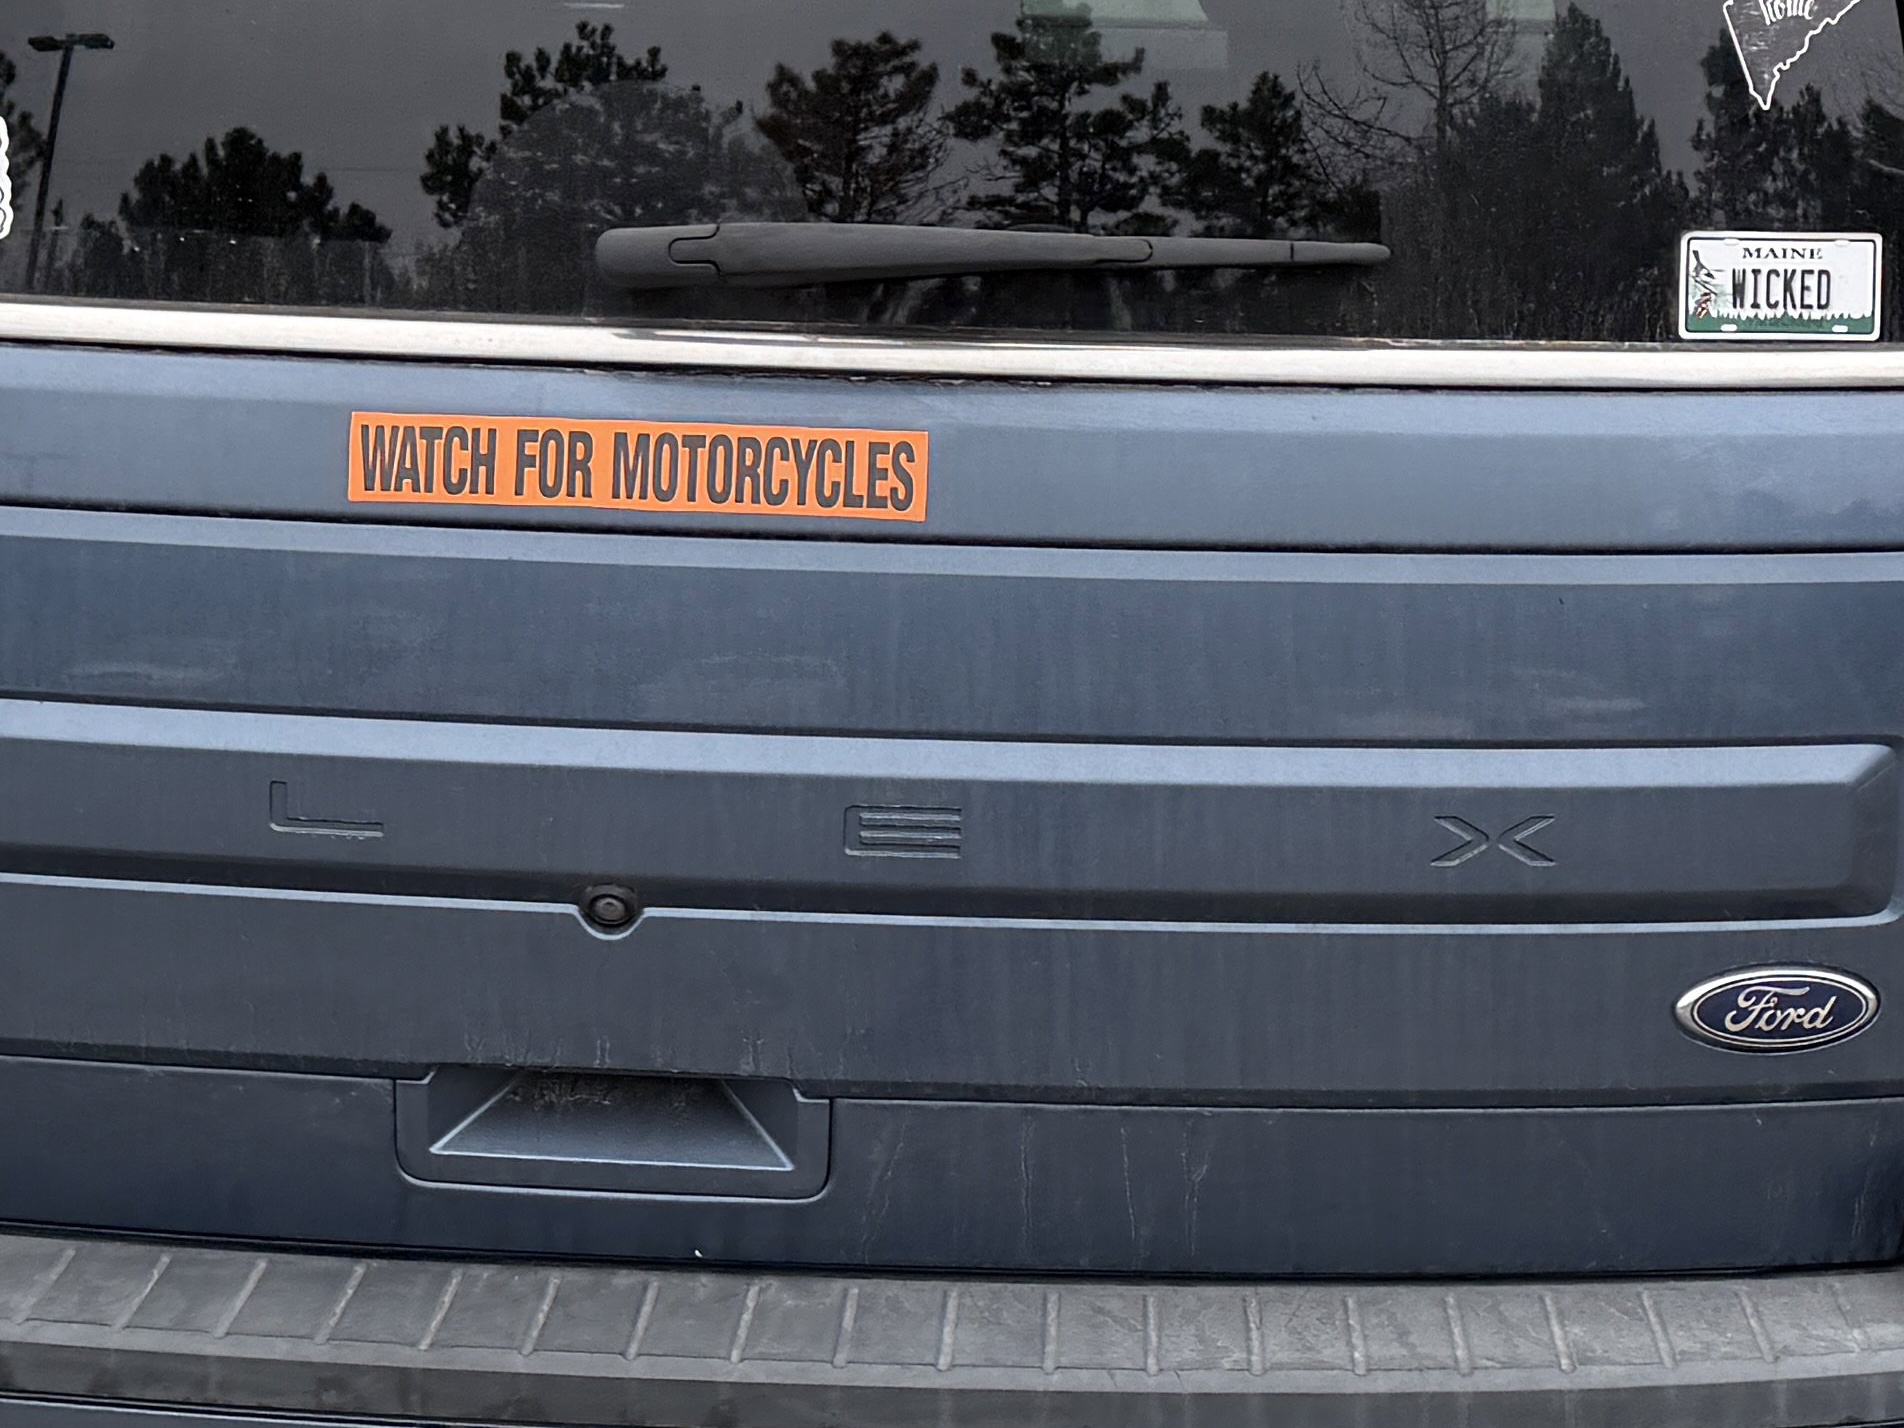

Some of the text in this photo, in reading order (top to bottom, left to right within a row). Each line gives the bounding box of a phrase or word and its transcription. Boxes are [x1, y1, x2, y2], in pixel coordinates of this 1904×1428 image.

[1742, 247, 1823, 260] MAINE
[1732, 268, 1831, 310] WICKED
[360, 424, 916, 512] WATCH FOR MOTORCYCLES
[1724, 985, 1838, 1032] Ford
